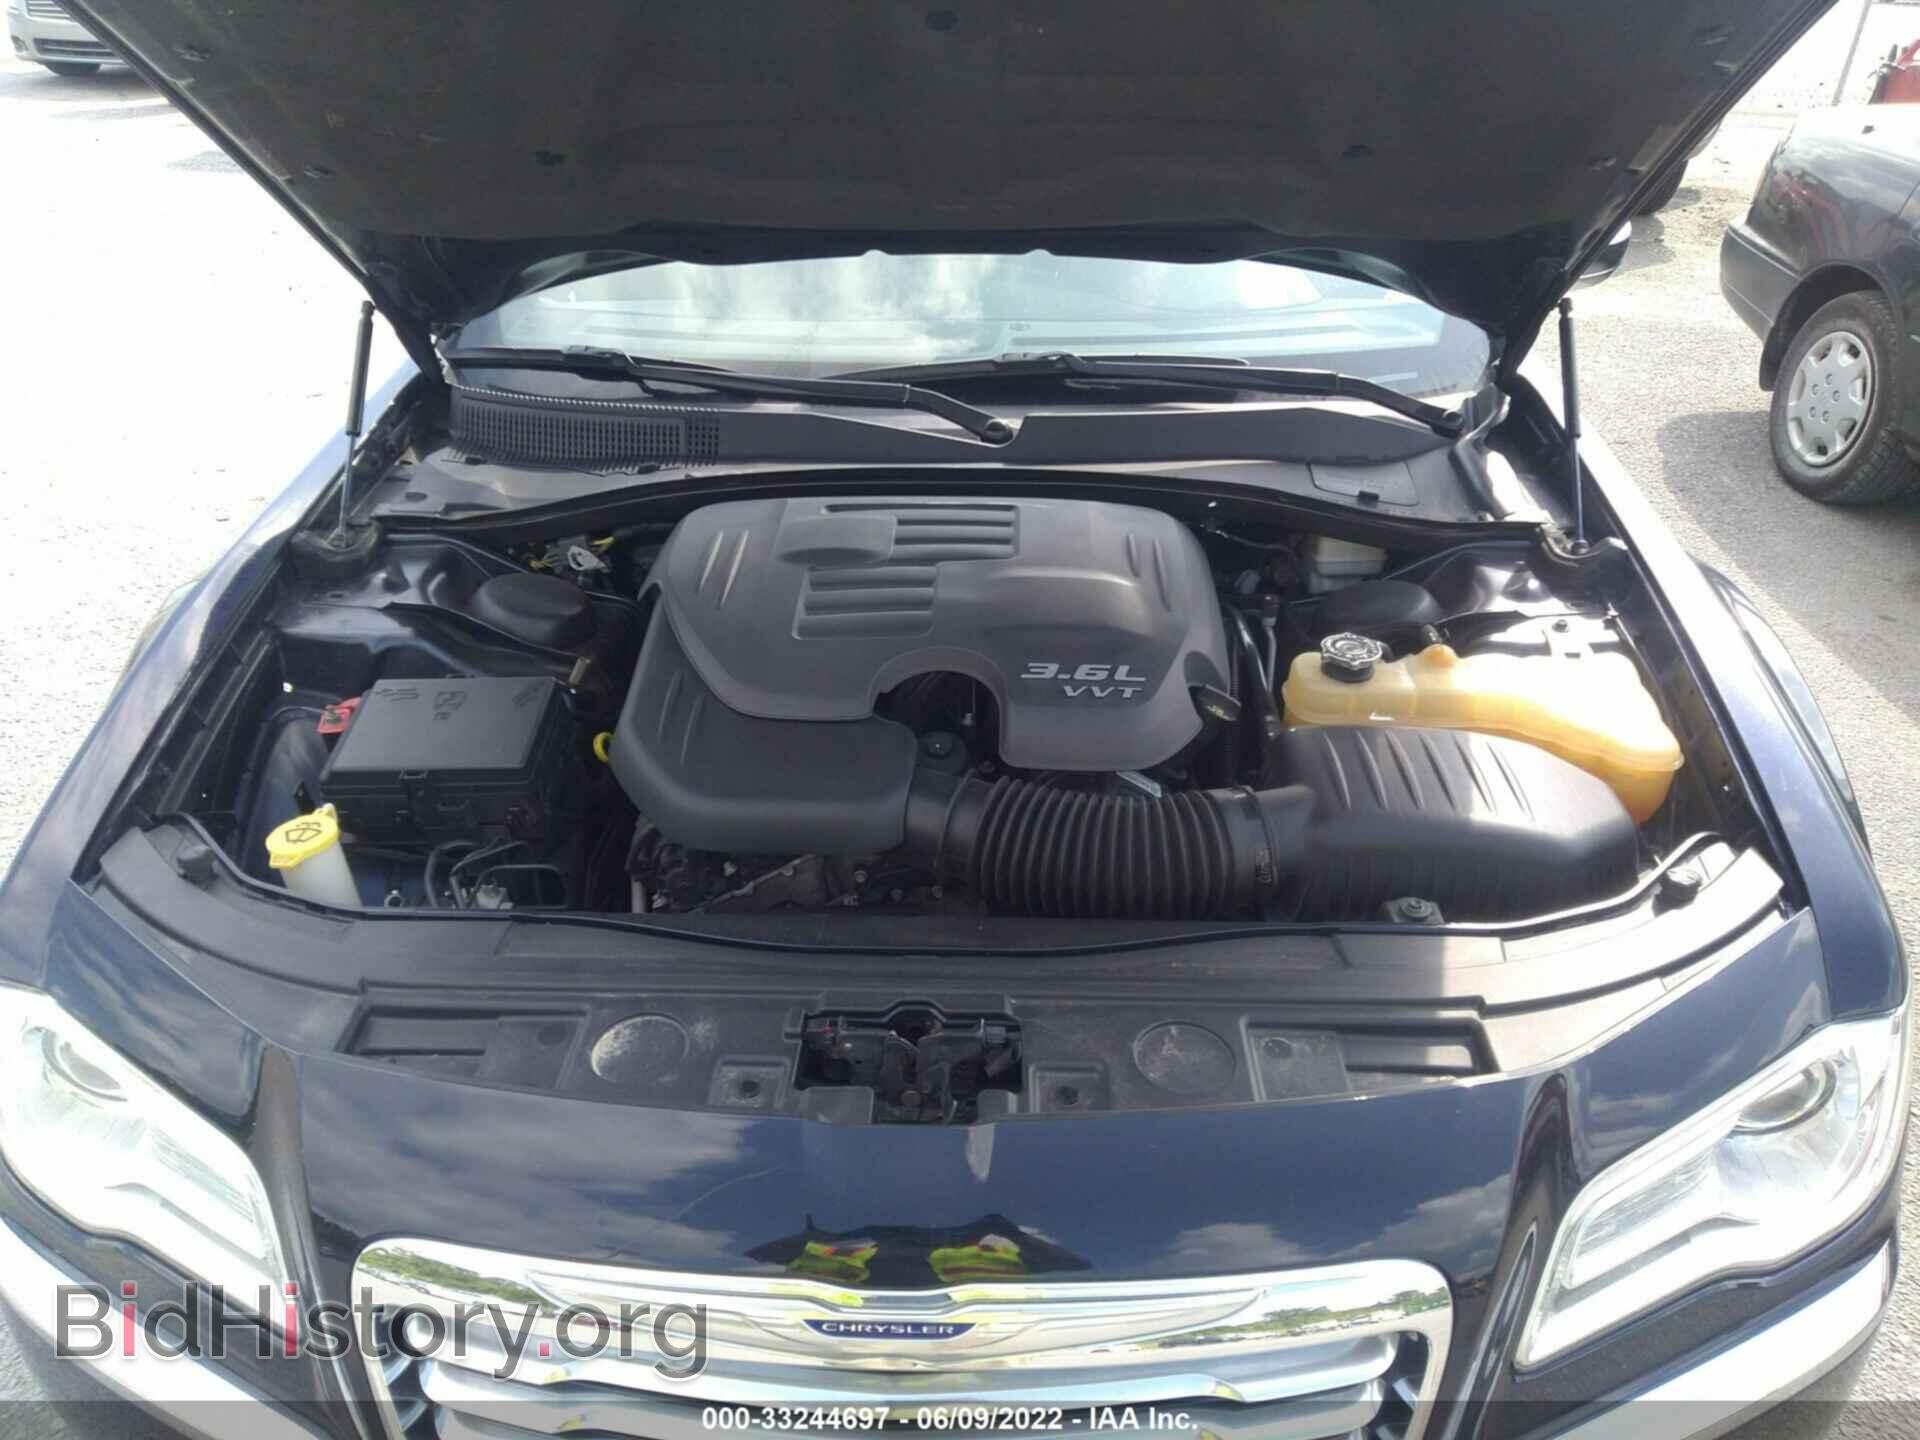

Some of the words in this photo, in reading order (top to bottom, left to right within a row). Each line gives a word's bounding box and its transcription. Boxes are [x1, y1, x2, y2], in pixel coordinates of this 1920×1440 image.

[1020, 661, 1147, 682] 3.6L
[1063, 685, 1143, 699] VVT
[821, 1322, 955, 1335] CHRYSLER
